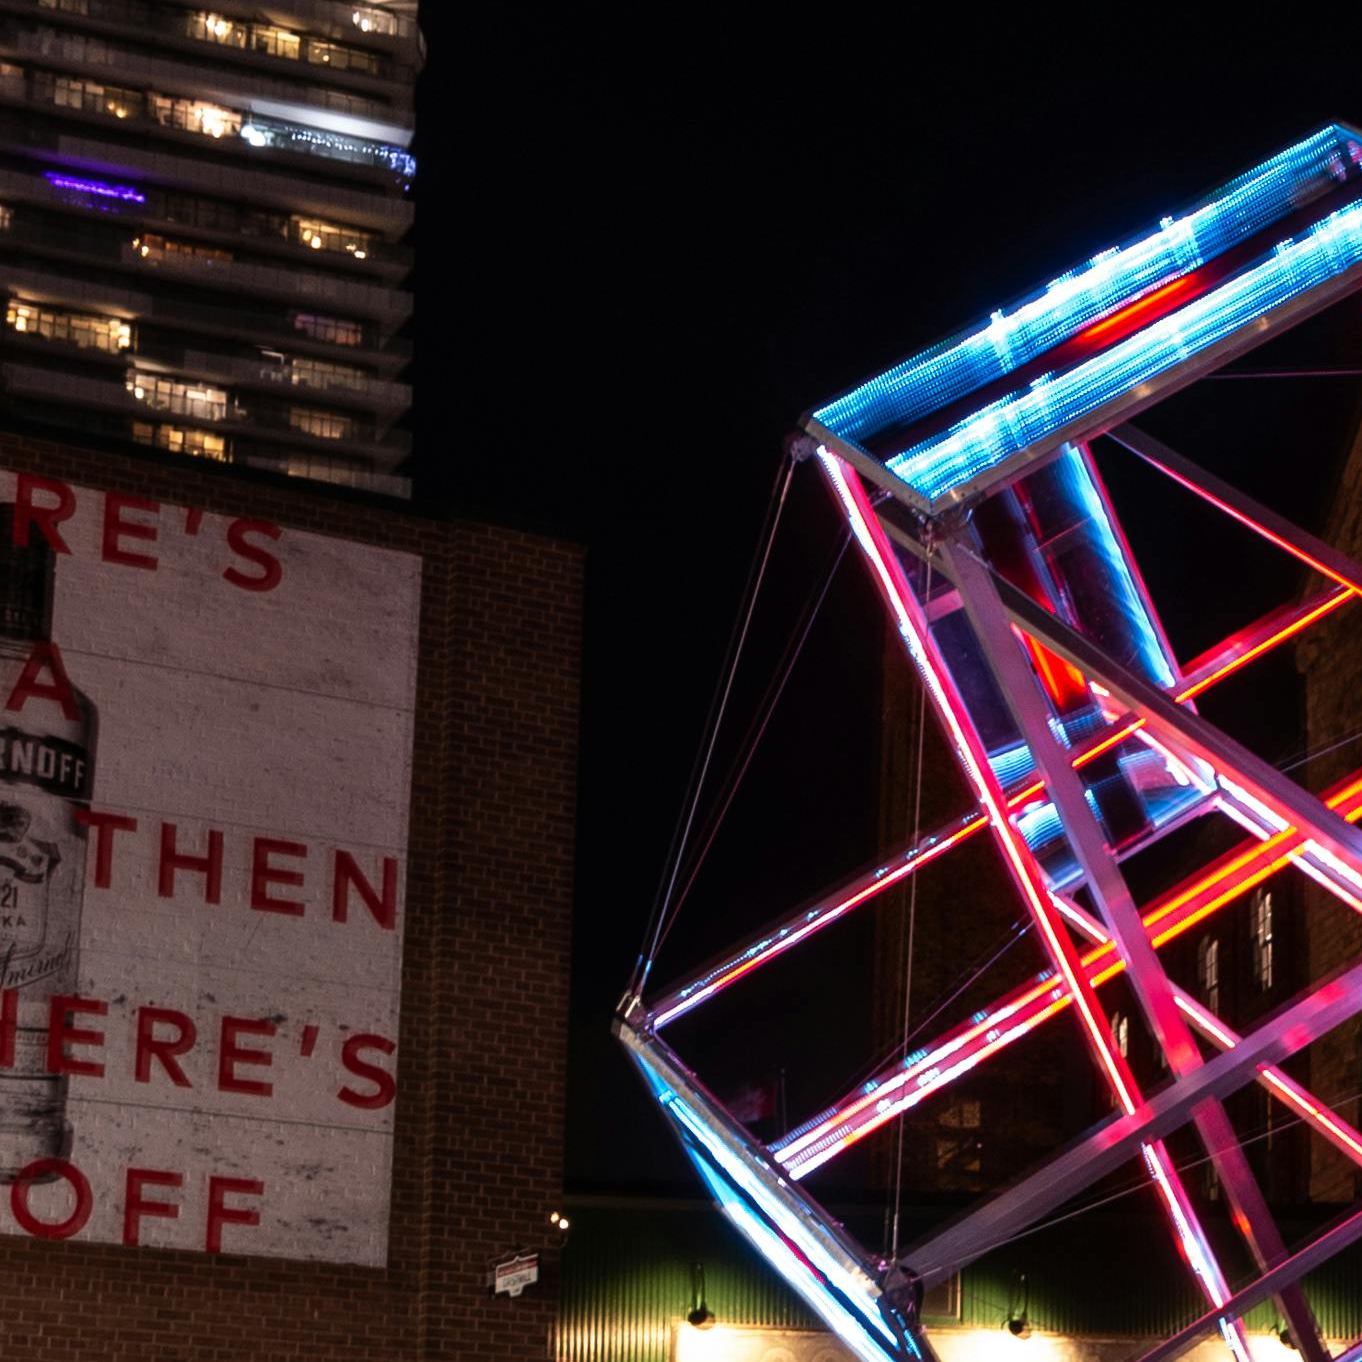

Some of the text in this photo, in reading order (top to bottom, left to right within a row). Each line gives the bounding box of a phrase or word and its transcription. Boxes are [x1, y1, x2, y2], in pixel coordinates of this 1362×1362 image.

[6, 642, 81, 722] A
[0, 738, 85, 789] NOFF
[72, 807, 398, 931] THEN
[11, 1158, 265, 1254] OFF
